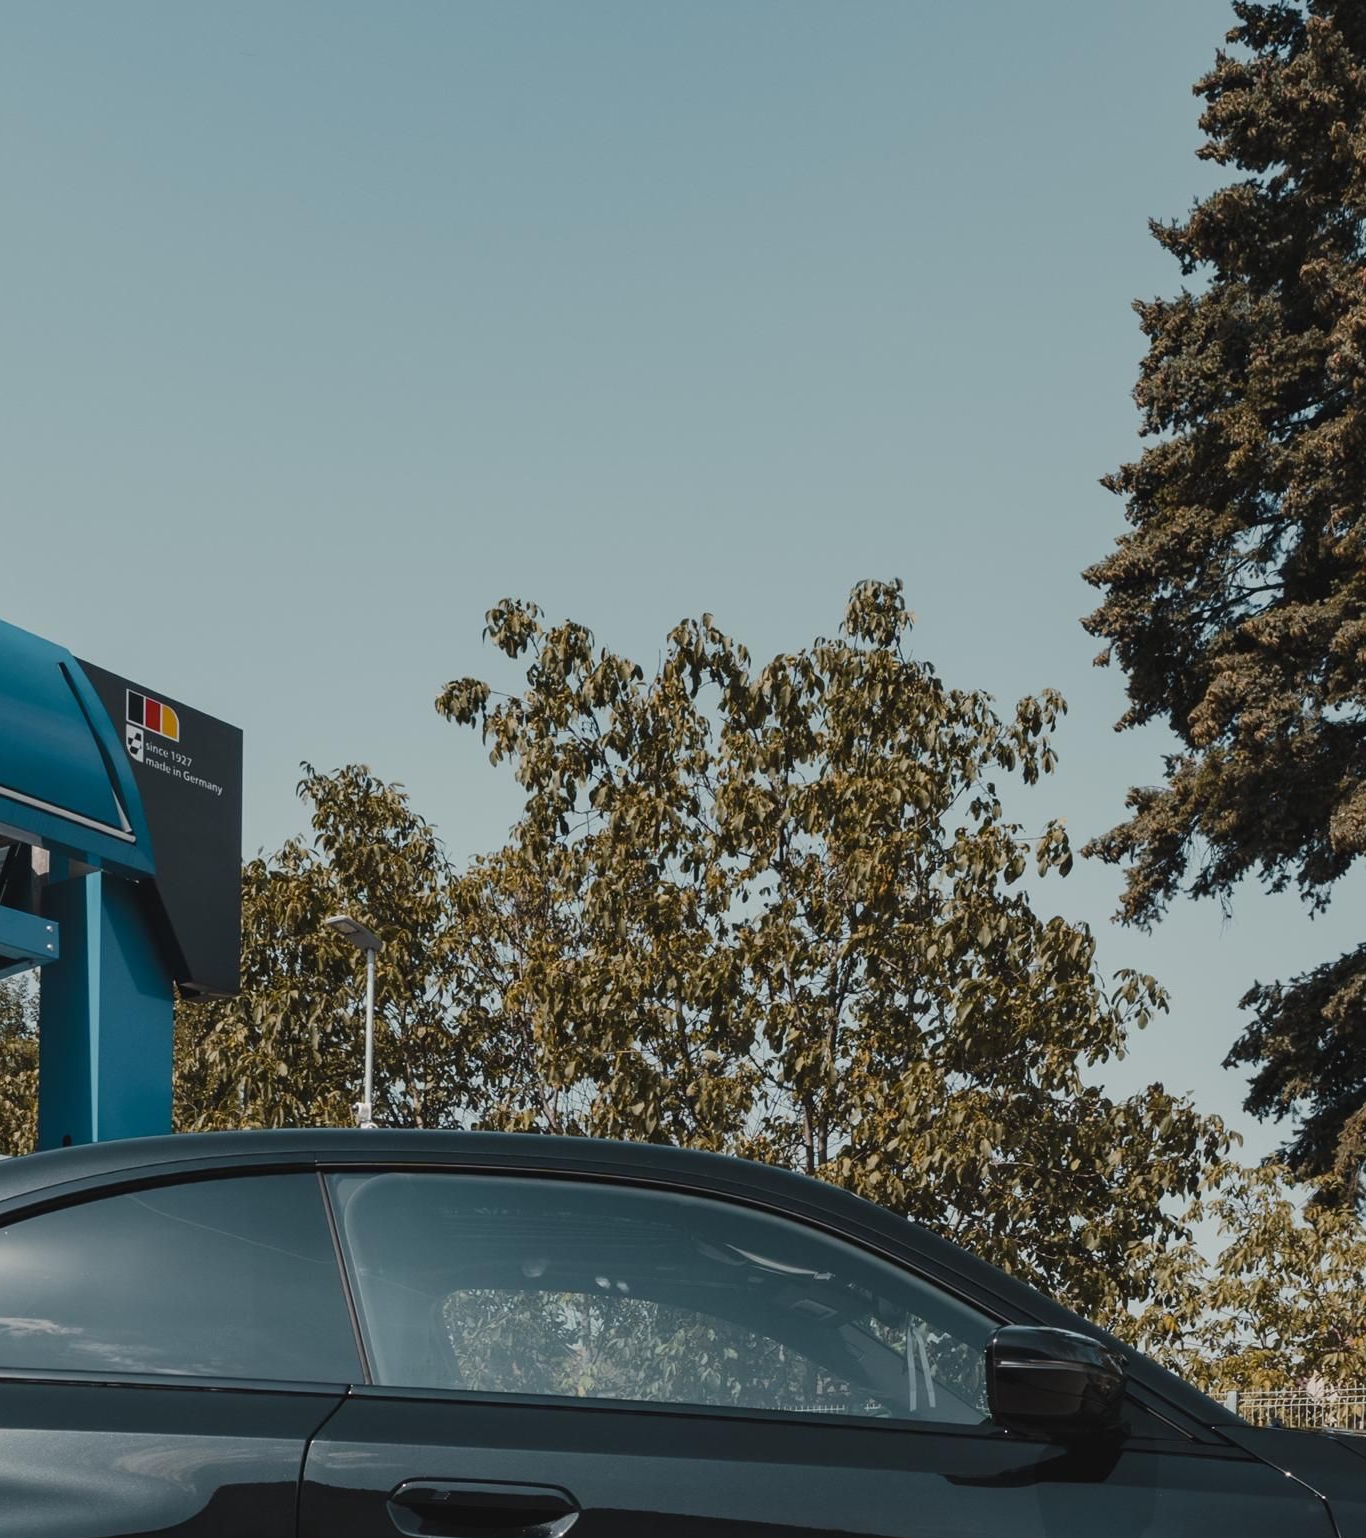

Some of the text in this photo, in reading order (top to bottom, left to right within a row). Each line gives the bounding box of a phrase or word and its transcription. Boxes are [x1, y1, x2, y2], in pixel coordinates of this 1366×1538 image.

[145, 741, 192, 767] since 1927
[145, 758, 223, 796] made in Germany
